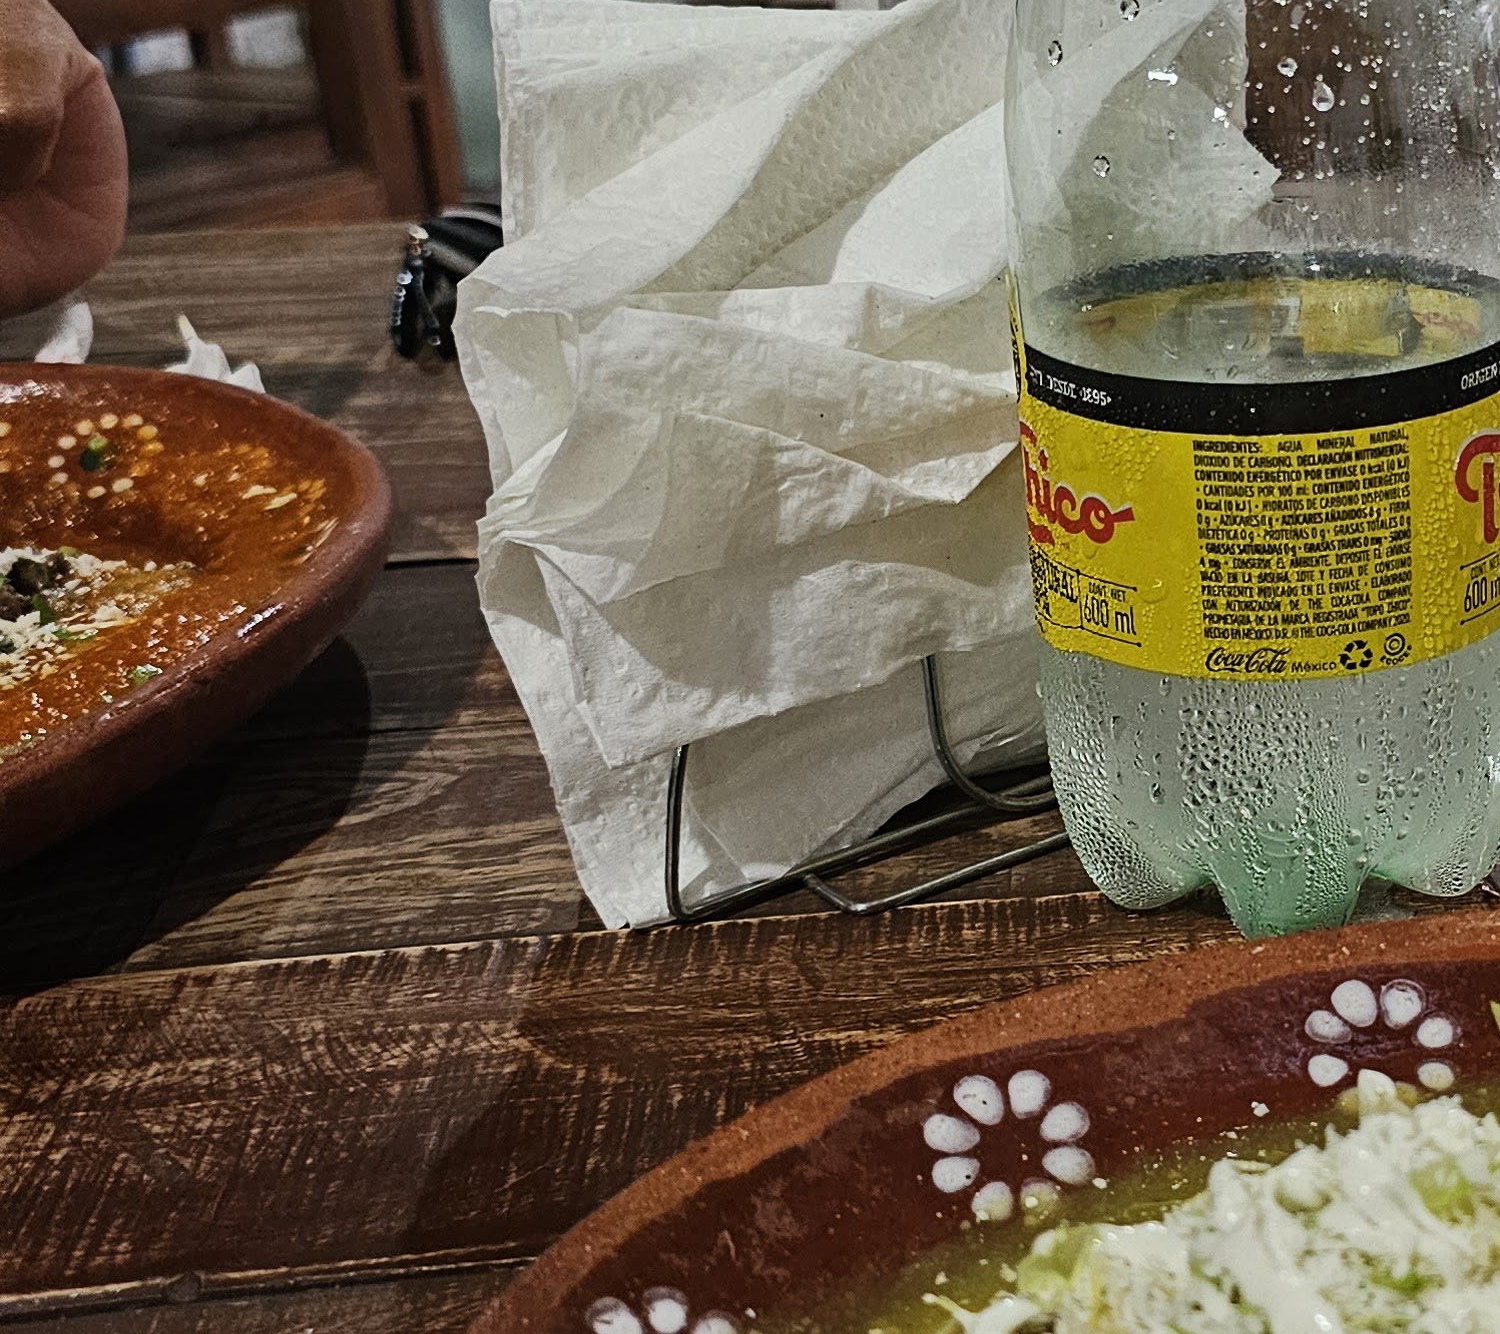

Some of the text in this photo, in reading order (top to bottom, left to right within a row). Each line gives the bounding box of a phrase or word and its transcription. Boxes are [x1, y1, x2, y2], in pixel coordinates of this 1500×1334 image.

[1461, 362, 1498, 390] ORIGEN
[1192, 440, 1263, 453] INGREDIENTES:
[1277, 441, 1303, 452] AGUA
[1317, 436, 1355, 449] MINERAL
[1233, 457, 1245, 468] DE
[1195, 469, 1244, 482] CONTENIDO
[1304, 469, 1322, 480] POR
[1325, 464, 1357, 479] ENVASE
[1203, 484, 1255, 497] CANTIDADES
[1258, 486, 1275, 497] POR
[1279, 485, 1293, 496] 100
[1312, 479, 1360, 495] CONTENIDO
[1306, 498, 1318, 510] DE
[1320, 494, 1360, 509] CARBONO
[1333, 522, 1365, 536] GRASAS
[1366, 516, 1398, 532] TOTALES
[1303, 540, 1336, 553] GRASAS
[1337, 537, 1362, 550] TRANS
[1335, 550, 1370, 565] DEPOSITE
[1374, 548, 1382, 559] EL
[1386, 542, 1411, 558] ENVASE
[1329, 566, 1354, 580] FECHA
[1357, 564, 1369, 576] DE
[1374, 556, 1412, 574] CONSUMO
[1301, 584, 1313, 596] EN
[1316, 584, 1325, 595] EL
[1329, 580, 1360, 593] ENVASE
[1371, 570, 1412, 588] ELABORADO
[1289, 599, 1300, 610] DE
[1308, 598, 1323, 609] THE
[1331, 592, 1370, 607] COCA-COLA
[1464, 577, 1487, 613] 600
[1084, 594, 1109, 628] 600
[1114, 607, 1137, 636] ml
[1255, 614, 1265, 625] DE
[1268, 614, 1279, 625] LA
[1281, 613, 1310, 624] MARCA
[1300, 627, 1315, 638] THE
[1205, 647, 1337, 673] Coca-Cola México
